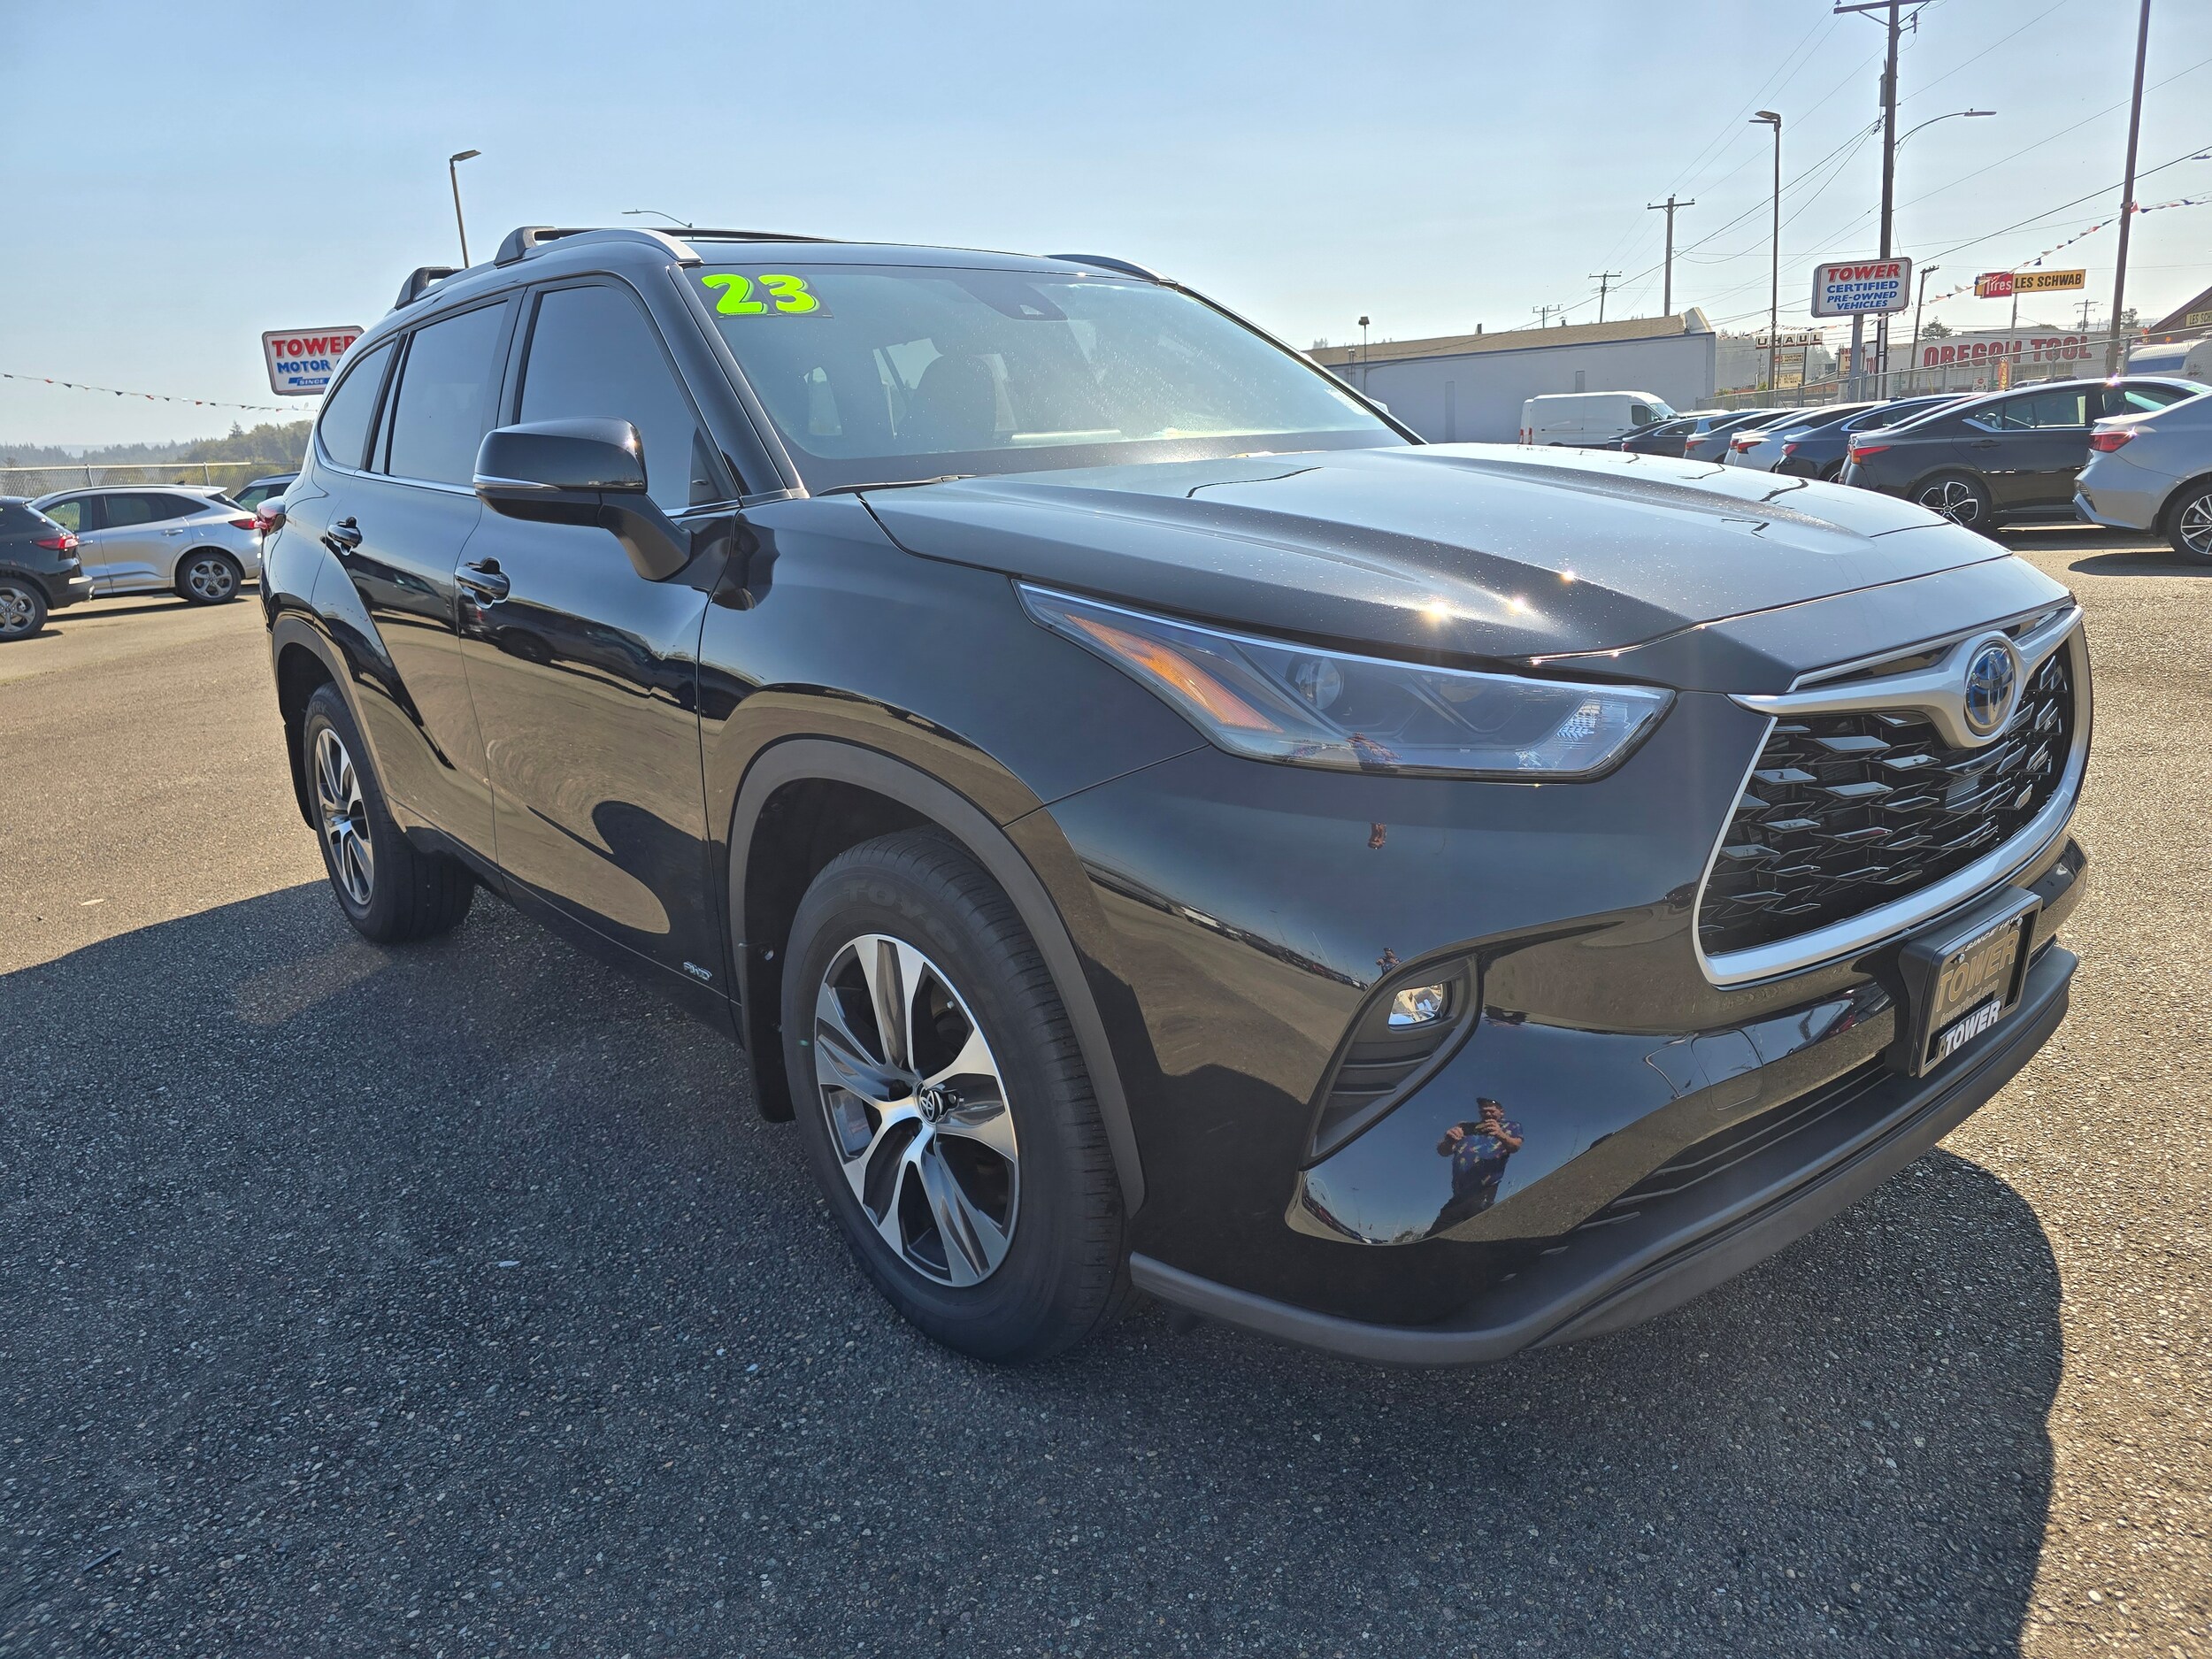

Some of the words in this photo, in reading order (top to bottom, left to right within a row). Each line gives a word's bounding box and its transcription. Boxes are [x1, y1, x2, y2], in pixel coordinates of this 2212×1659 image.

[1827, 264, 1901, 282] TOWER
[2014, 277, 2034, 289] LES
[2037, 273, 2082, 288] SCHWAB
[701, 273, 821, 315] 23
[1826, 280, 1900, 293] CERTIFIED
[1826, 291, 1898, 303] PRE-OWNED
[1836, 300, 1888, 311] VEHICLES
[2189, 314, 2199, 325] LES
[1924, 340, 2023, 369] OREGON
[2031, 335, 2093, 362] TOOL
[276, 359, 332, 373] MOTOR
[841, 879, 957, 954] TOYO
[1964, 927, 1997, 952] SINCE
[1936, 929, 2020, 1012] TOWER
[1939, 979, 2000, 1028] towerford.com
[1945, 999, 2001, 1056] TOWER
